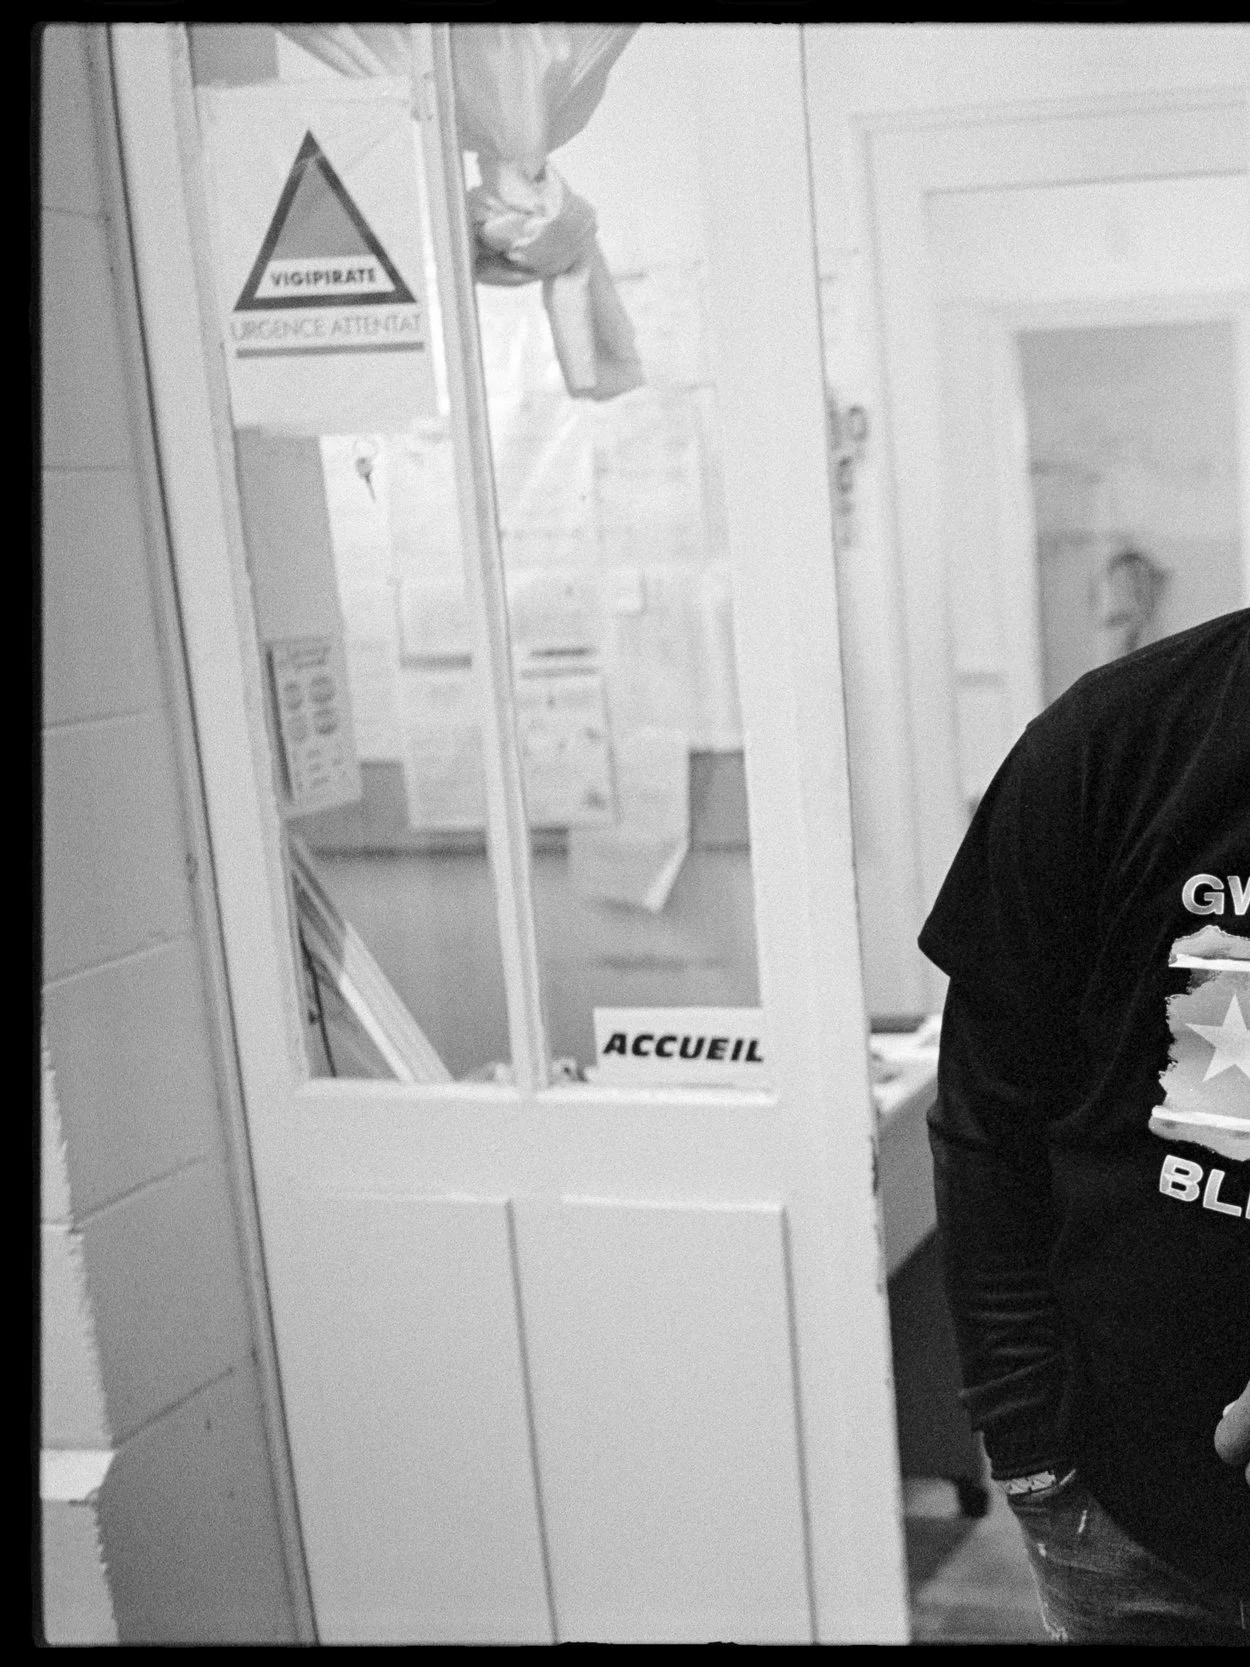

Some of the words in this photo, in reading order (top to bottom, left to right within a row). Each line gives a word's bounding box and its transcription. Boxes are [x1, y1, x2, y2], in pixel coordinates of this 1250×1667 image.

[270, 267, 376, 287] VIGIPIRATE
[229, 318, 329, 341] URGENCE
[330, 313, 422, 336] ATTENTAT
[603, 1032, 764, 1063] ACCUEIL
